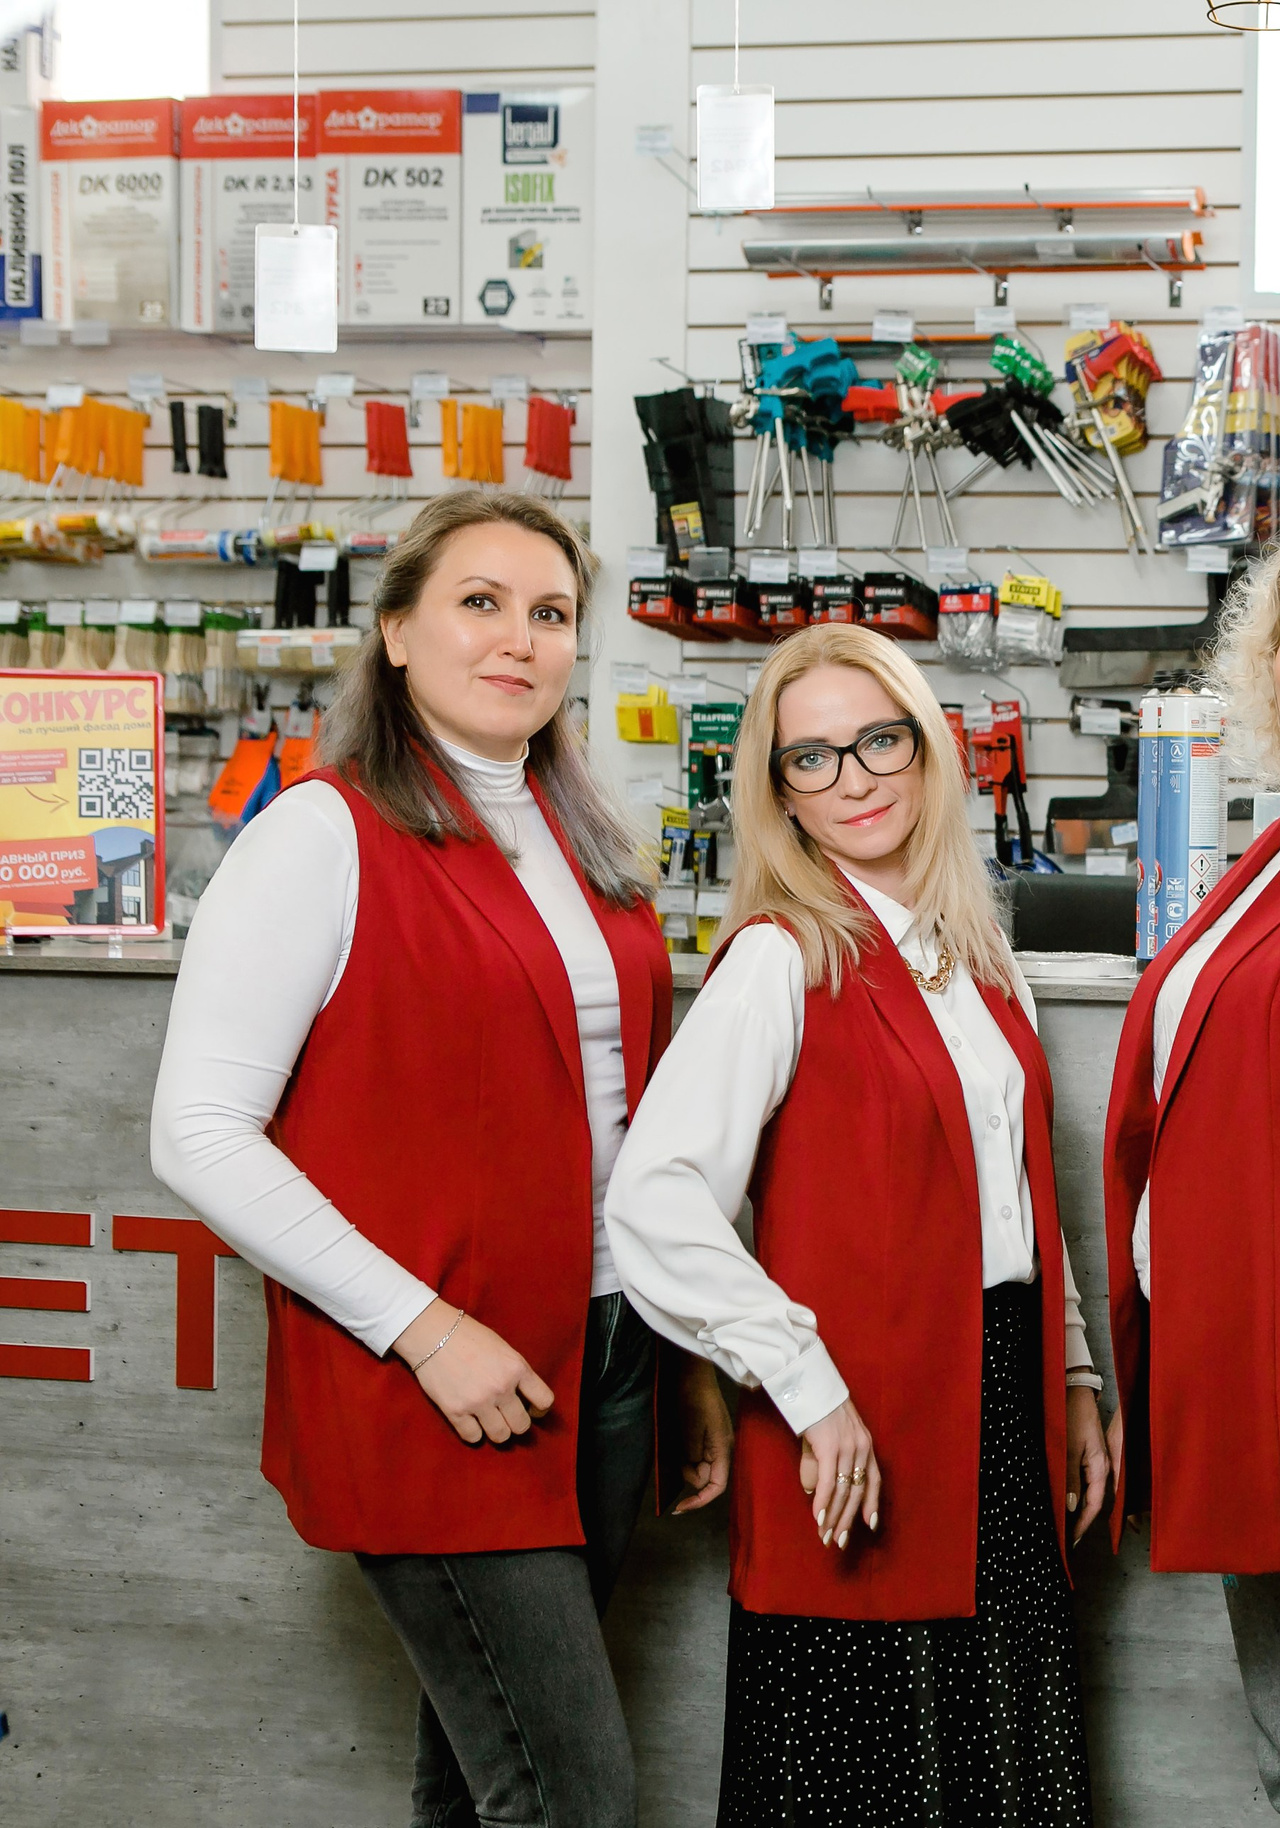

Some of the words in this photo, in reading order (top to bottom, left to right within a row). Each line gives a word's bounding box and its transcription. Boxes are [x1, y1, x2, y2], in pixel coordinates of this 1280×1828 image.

[363, 168, 397, 188] DK
[405, 168, 444, 187] 502
[504, 172, 556, 204] ISOFIX
[18, 726, 33, 735] на
[35, 723, 80, 736] лучший
[83, 722, 120, 733] фасад
[123, 721, 152, 731] дома
[50, 849, 86, 861] ПРИЗ
[18, 862, 58, 881] 000
[60, 866, 86, 879] руб.
